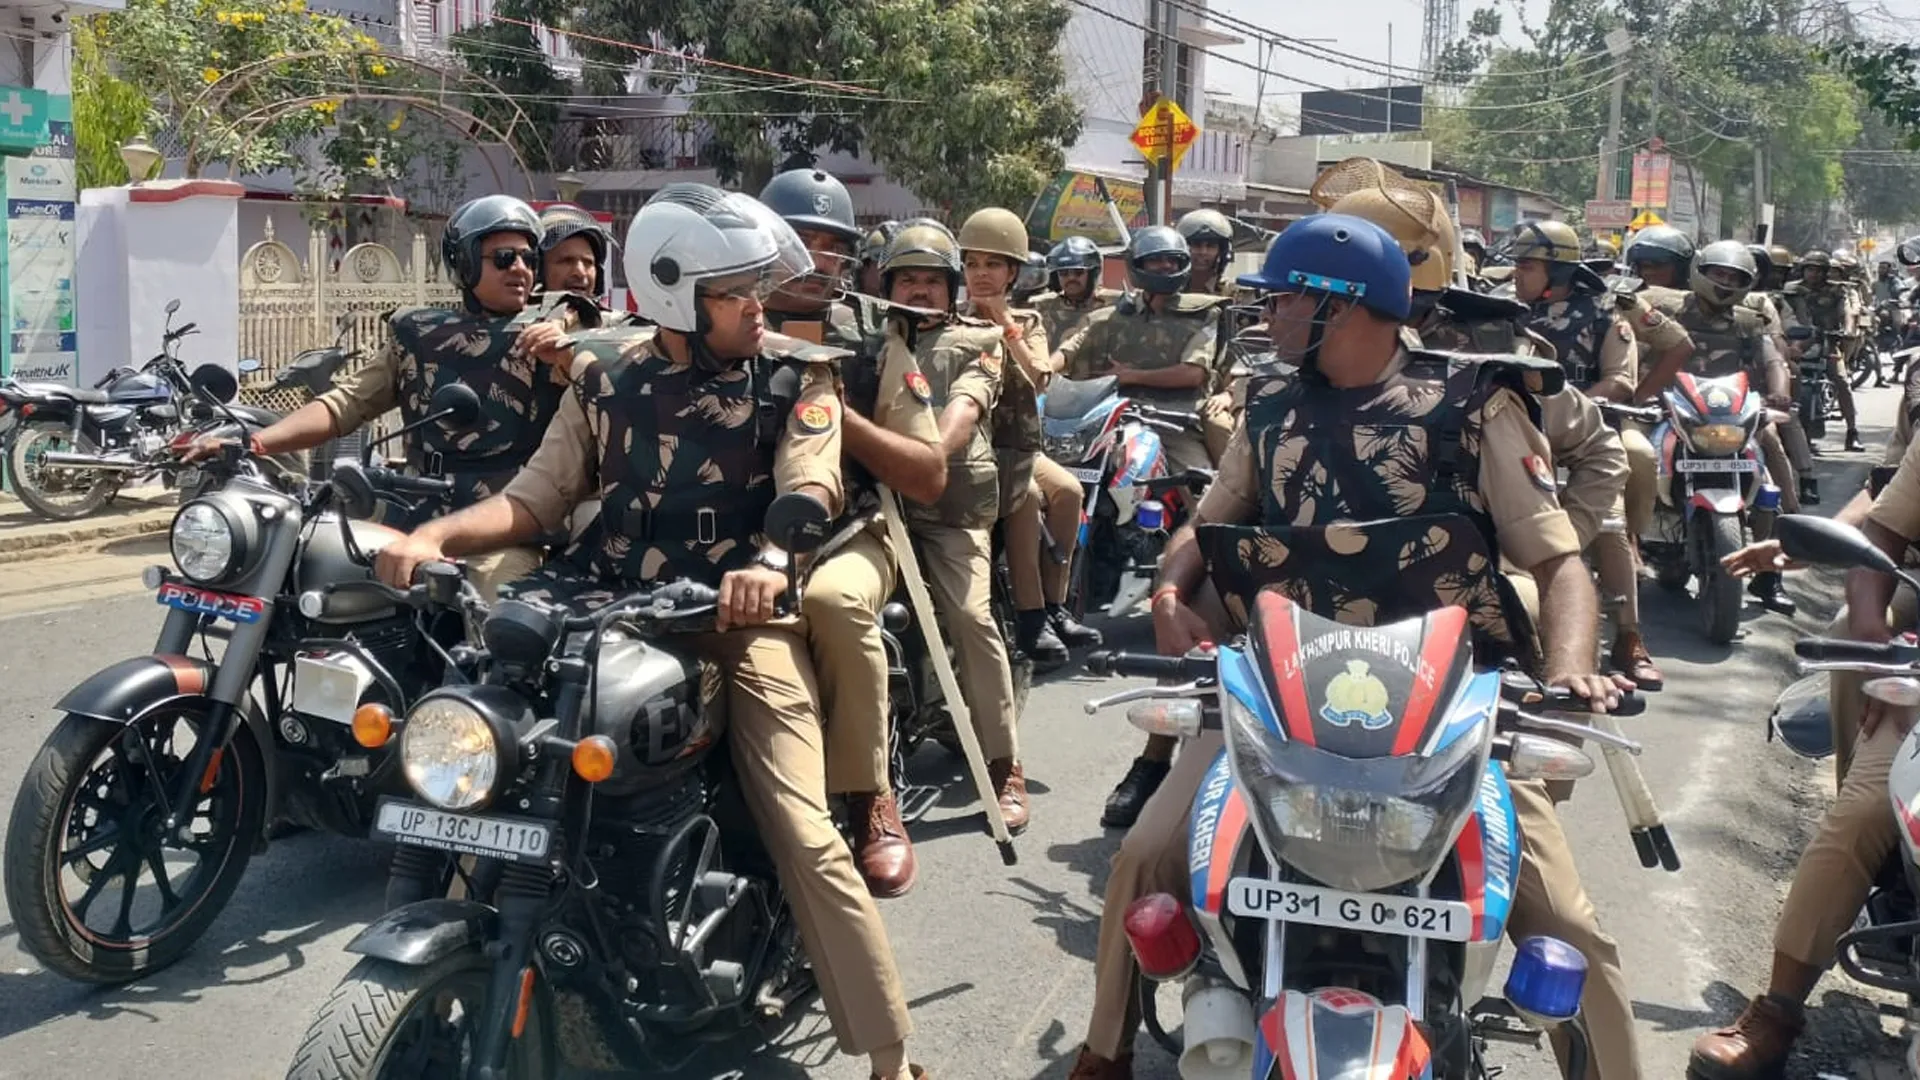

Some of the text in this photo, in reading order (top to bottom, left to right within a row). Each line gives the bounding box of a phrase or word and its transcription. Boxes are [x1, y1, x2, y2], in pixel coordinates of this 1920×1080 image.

[48, 134, 69, 147] AL
[1145, 134, 1183, 147] LIBRRY
[164, 587, 255, 618] POLICE
[1284, 629, 1351, 680] LAKHIMPUR
[1354, 631, 1391, 657] KHERI
[401, 810, 426, 832] UP
[435, 815, 484, 842] 13CJ
[493, 823, 542, 851] 1110
[1190, 803, 1219, 875] KHERI
[1243, 886, 1321, 917] UP31
[1339, 898, 1362, 922] G
